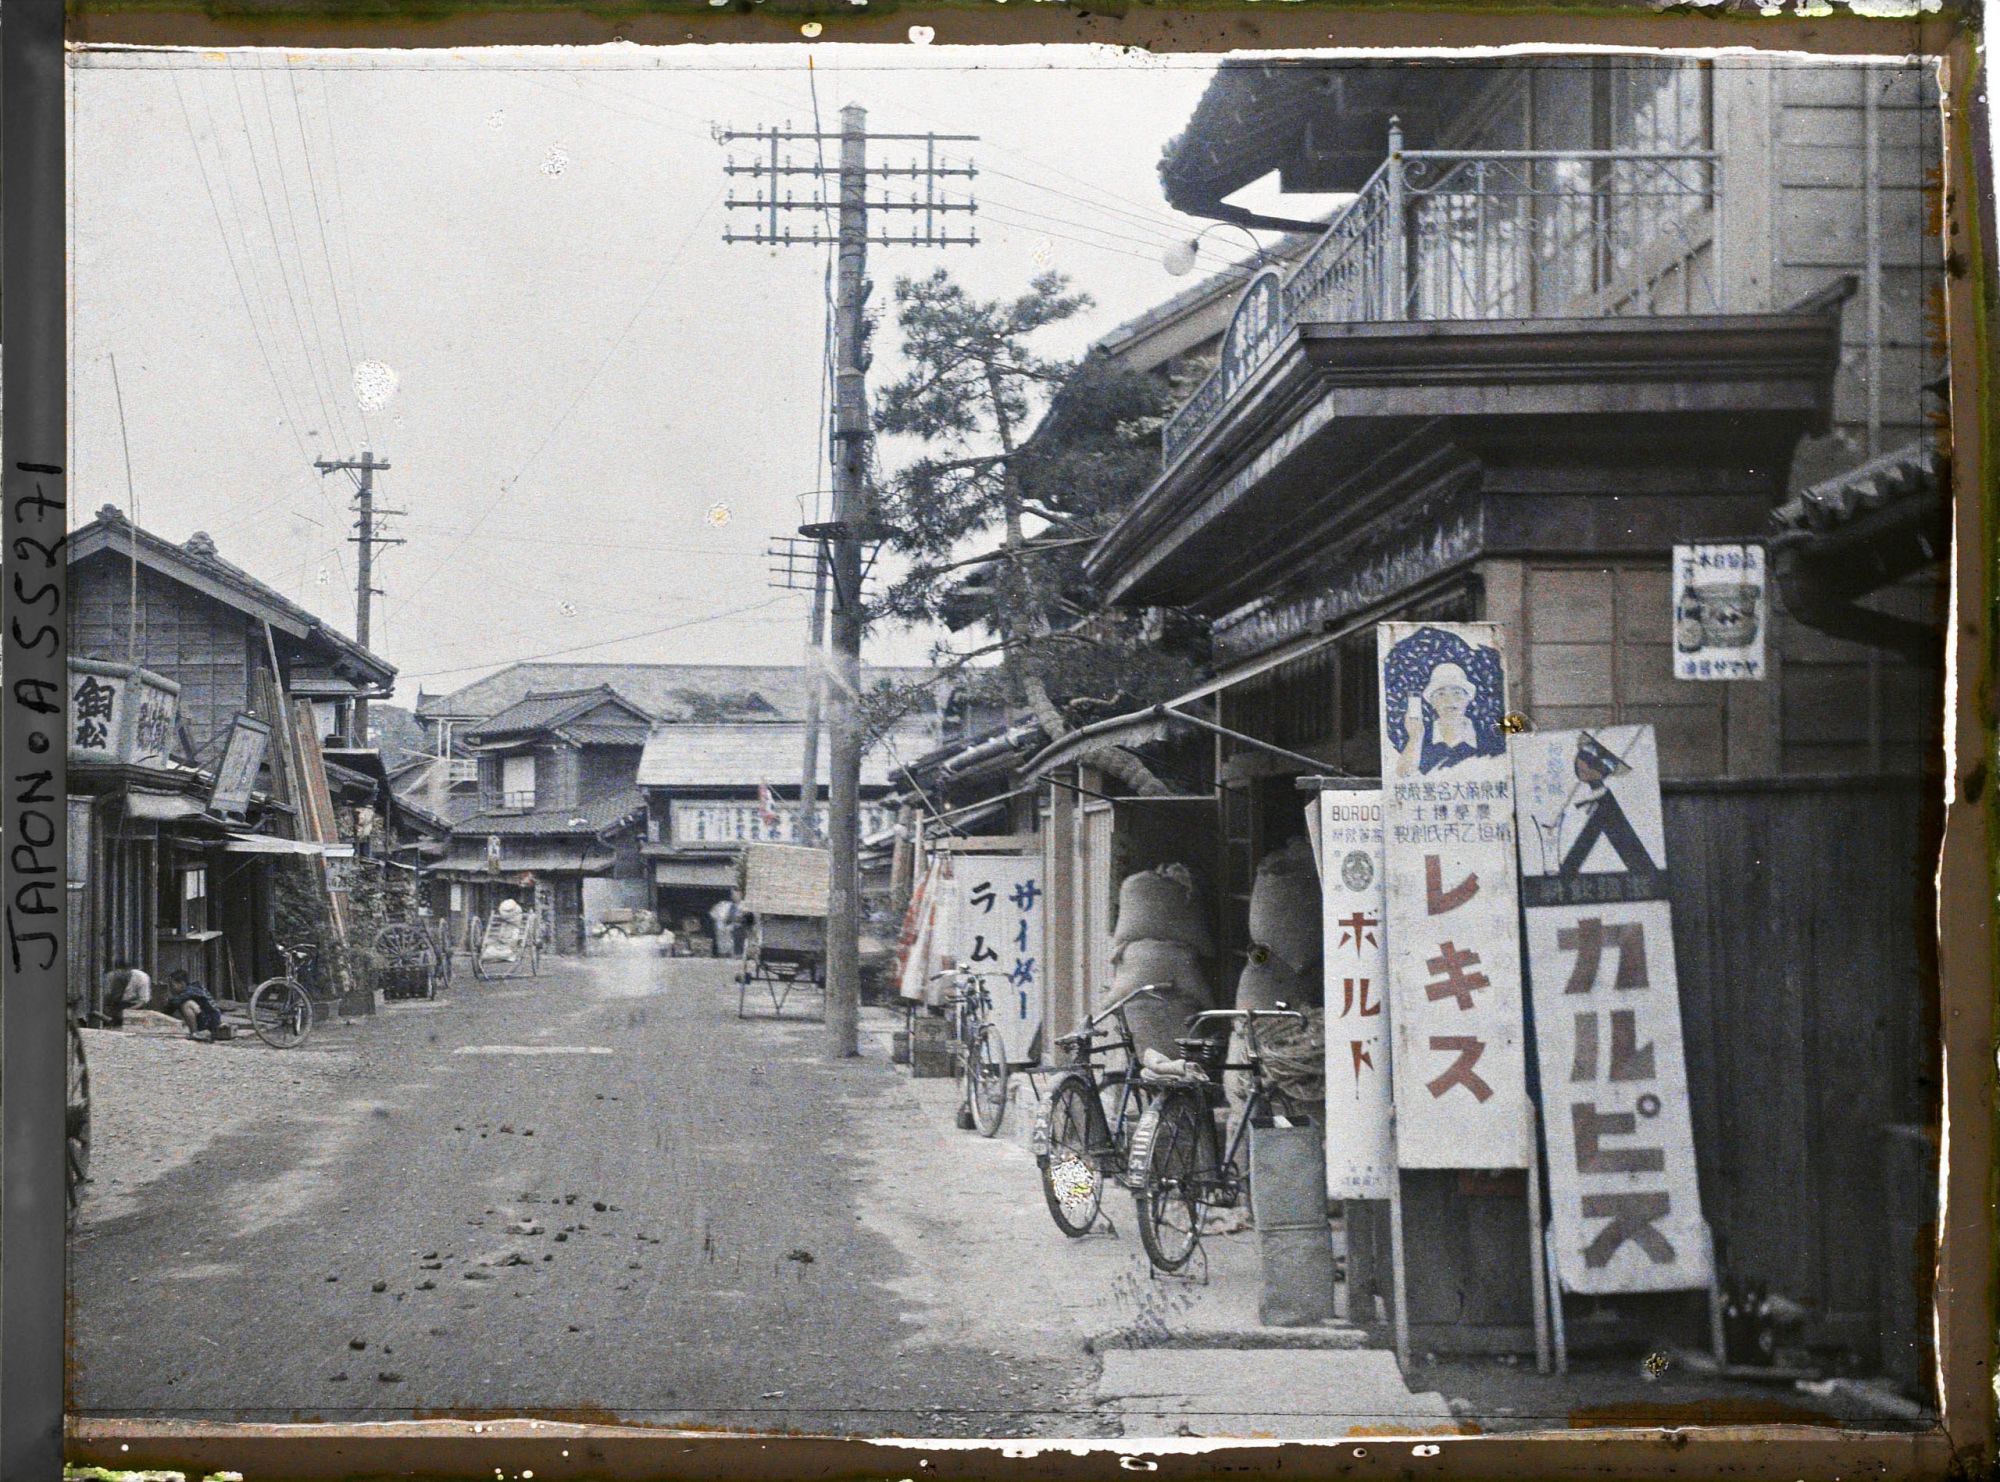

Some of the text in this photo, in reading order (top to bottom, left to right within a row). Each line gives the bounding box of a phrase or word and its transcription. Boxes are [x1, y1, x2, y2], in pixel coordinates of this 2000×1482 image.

[8, 769, 58, 973] JAPON
[1332, 805, 1380, 821] BORDO
[1009, 880, 1042, 1020] サイダー
[1338, 909, 1381, 1100] ボルド
[1425, 854, 1495, 1103] レキス
[1556, 917, 1677, 1270] カルピス
